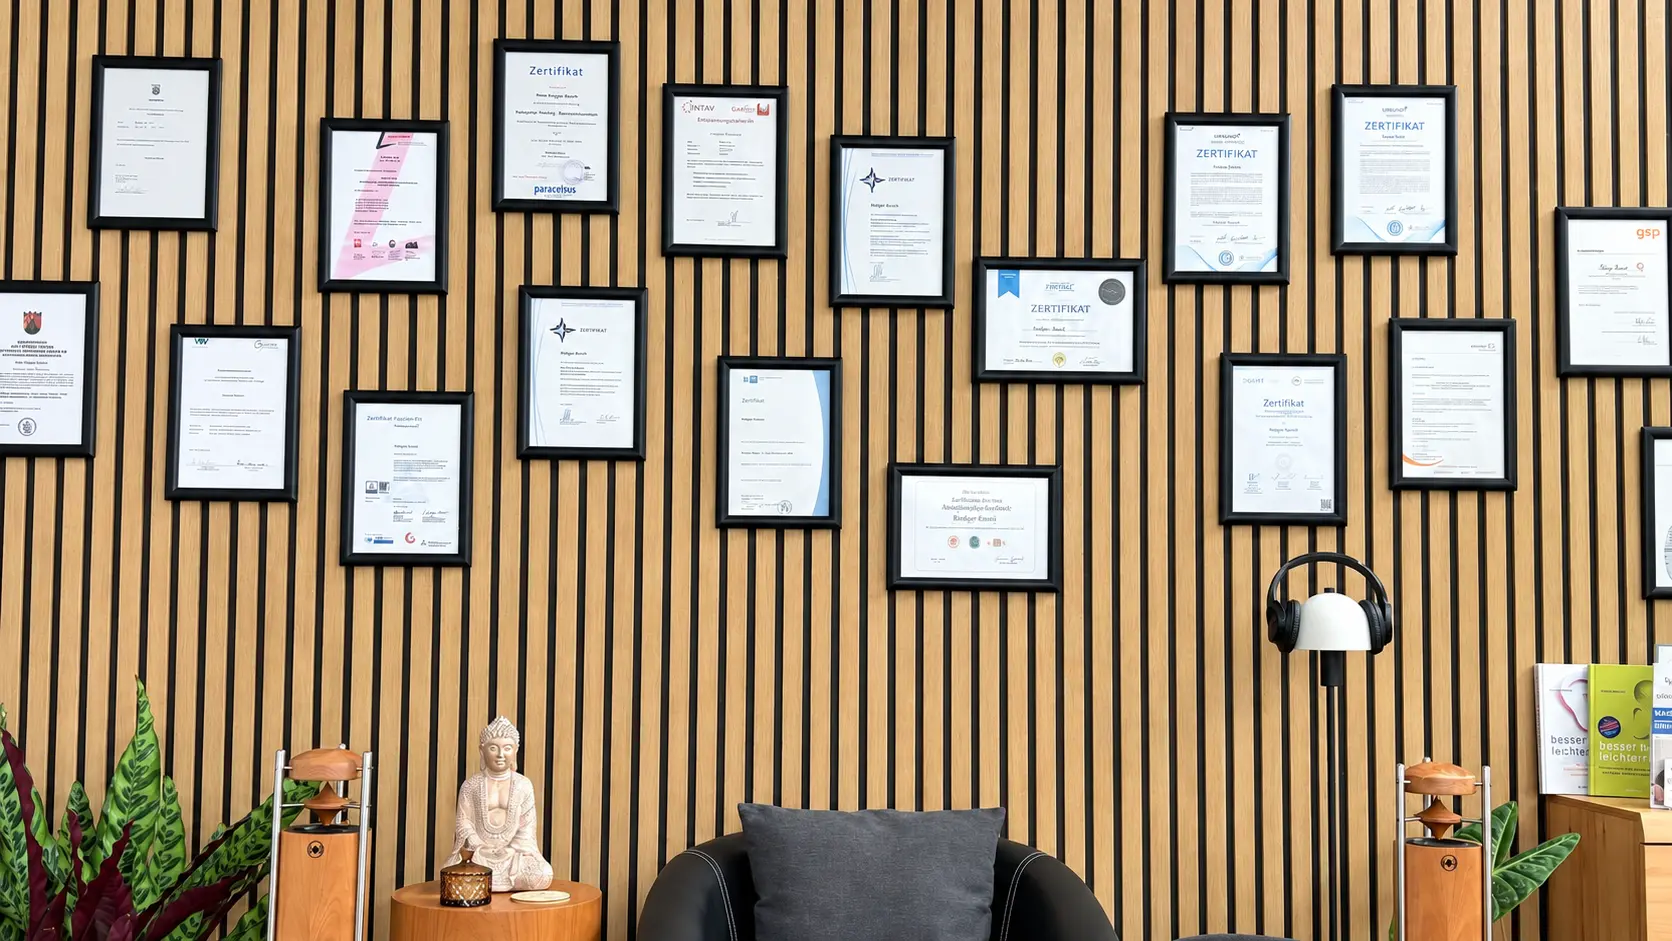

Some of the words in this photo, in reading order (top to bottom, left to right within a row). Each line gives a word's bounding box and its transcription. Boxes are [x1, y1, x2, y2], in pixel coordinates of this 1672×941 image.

[529, 65, 584, 77] Zertifikat
[1364, 121, 1426, 131] ZERTIFIKAT
[1196, 148, 1259, 159] ZERTIFIKAT
[534, 185, 577, 195] paracelsus
[1636, 228, 1661, 240] gsp
[1030, 304, 1092, 314] ZERTIFIKAT
[1263, 398, 1305, 408] Zertifikat
[1550, 735, 1588, 745] besser
[1599, 741, 1636, 751] besser
